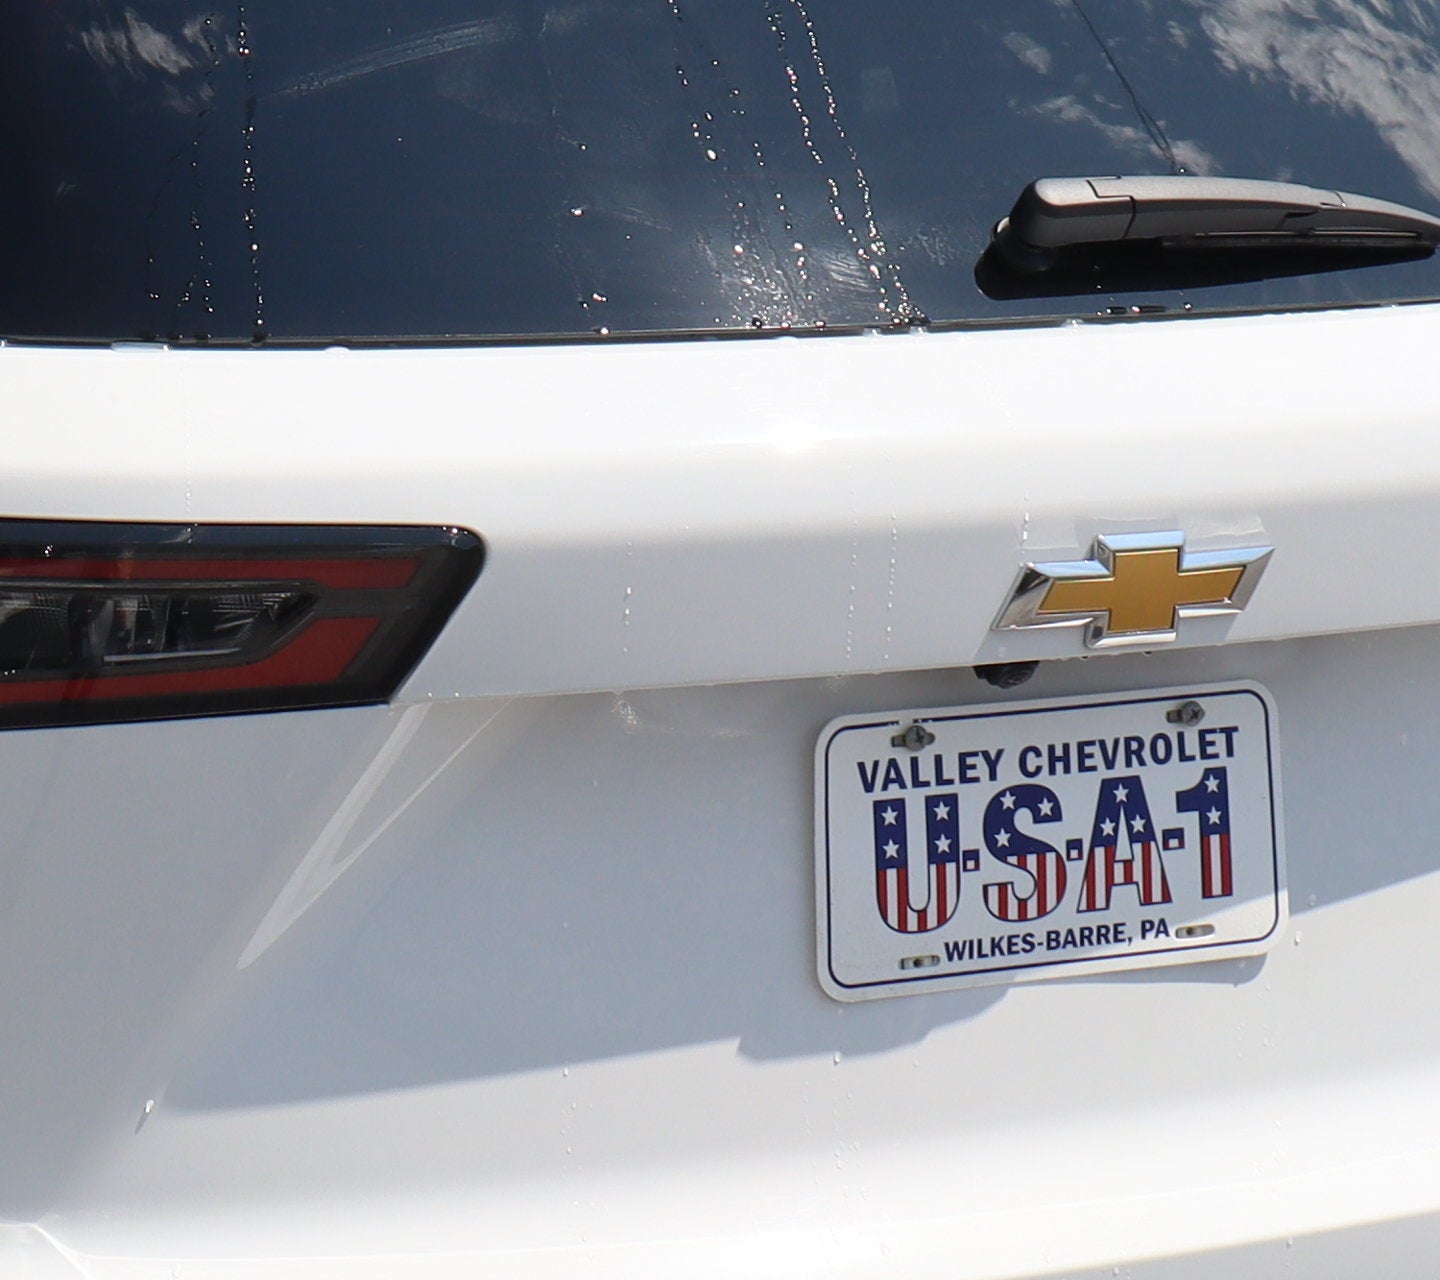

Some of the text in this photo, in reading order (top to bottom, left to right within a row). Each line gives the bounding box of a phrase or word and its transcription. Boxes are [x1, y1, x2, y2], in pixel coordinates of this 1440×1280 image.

[857, 726, 1239, 794] VALLEY CHEVROLET
[944, 917, 1171, 962] WILKES-BARRE, PA
